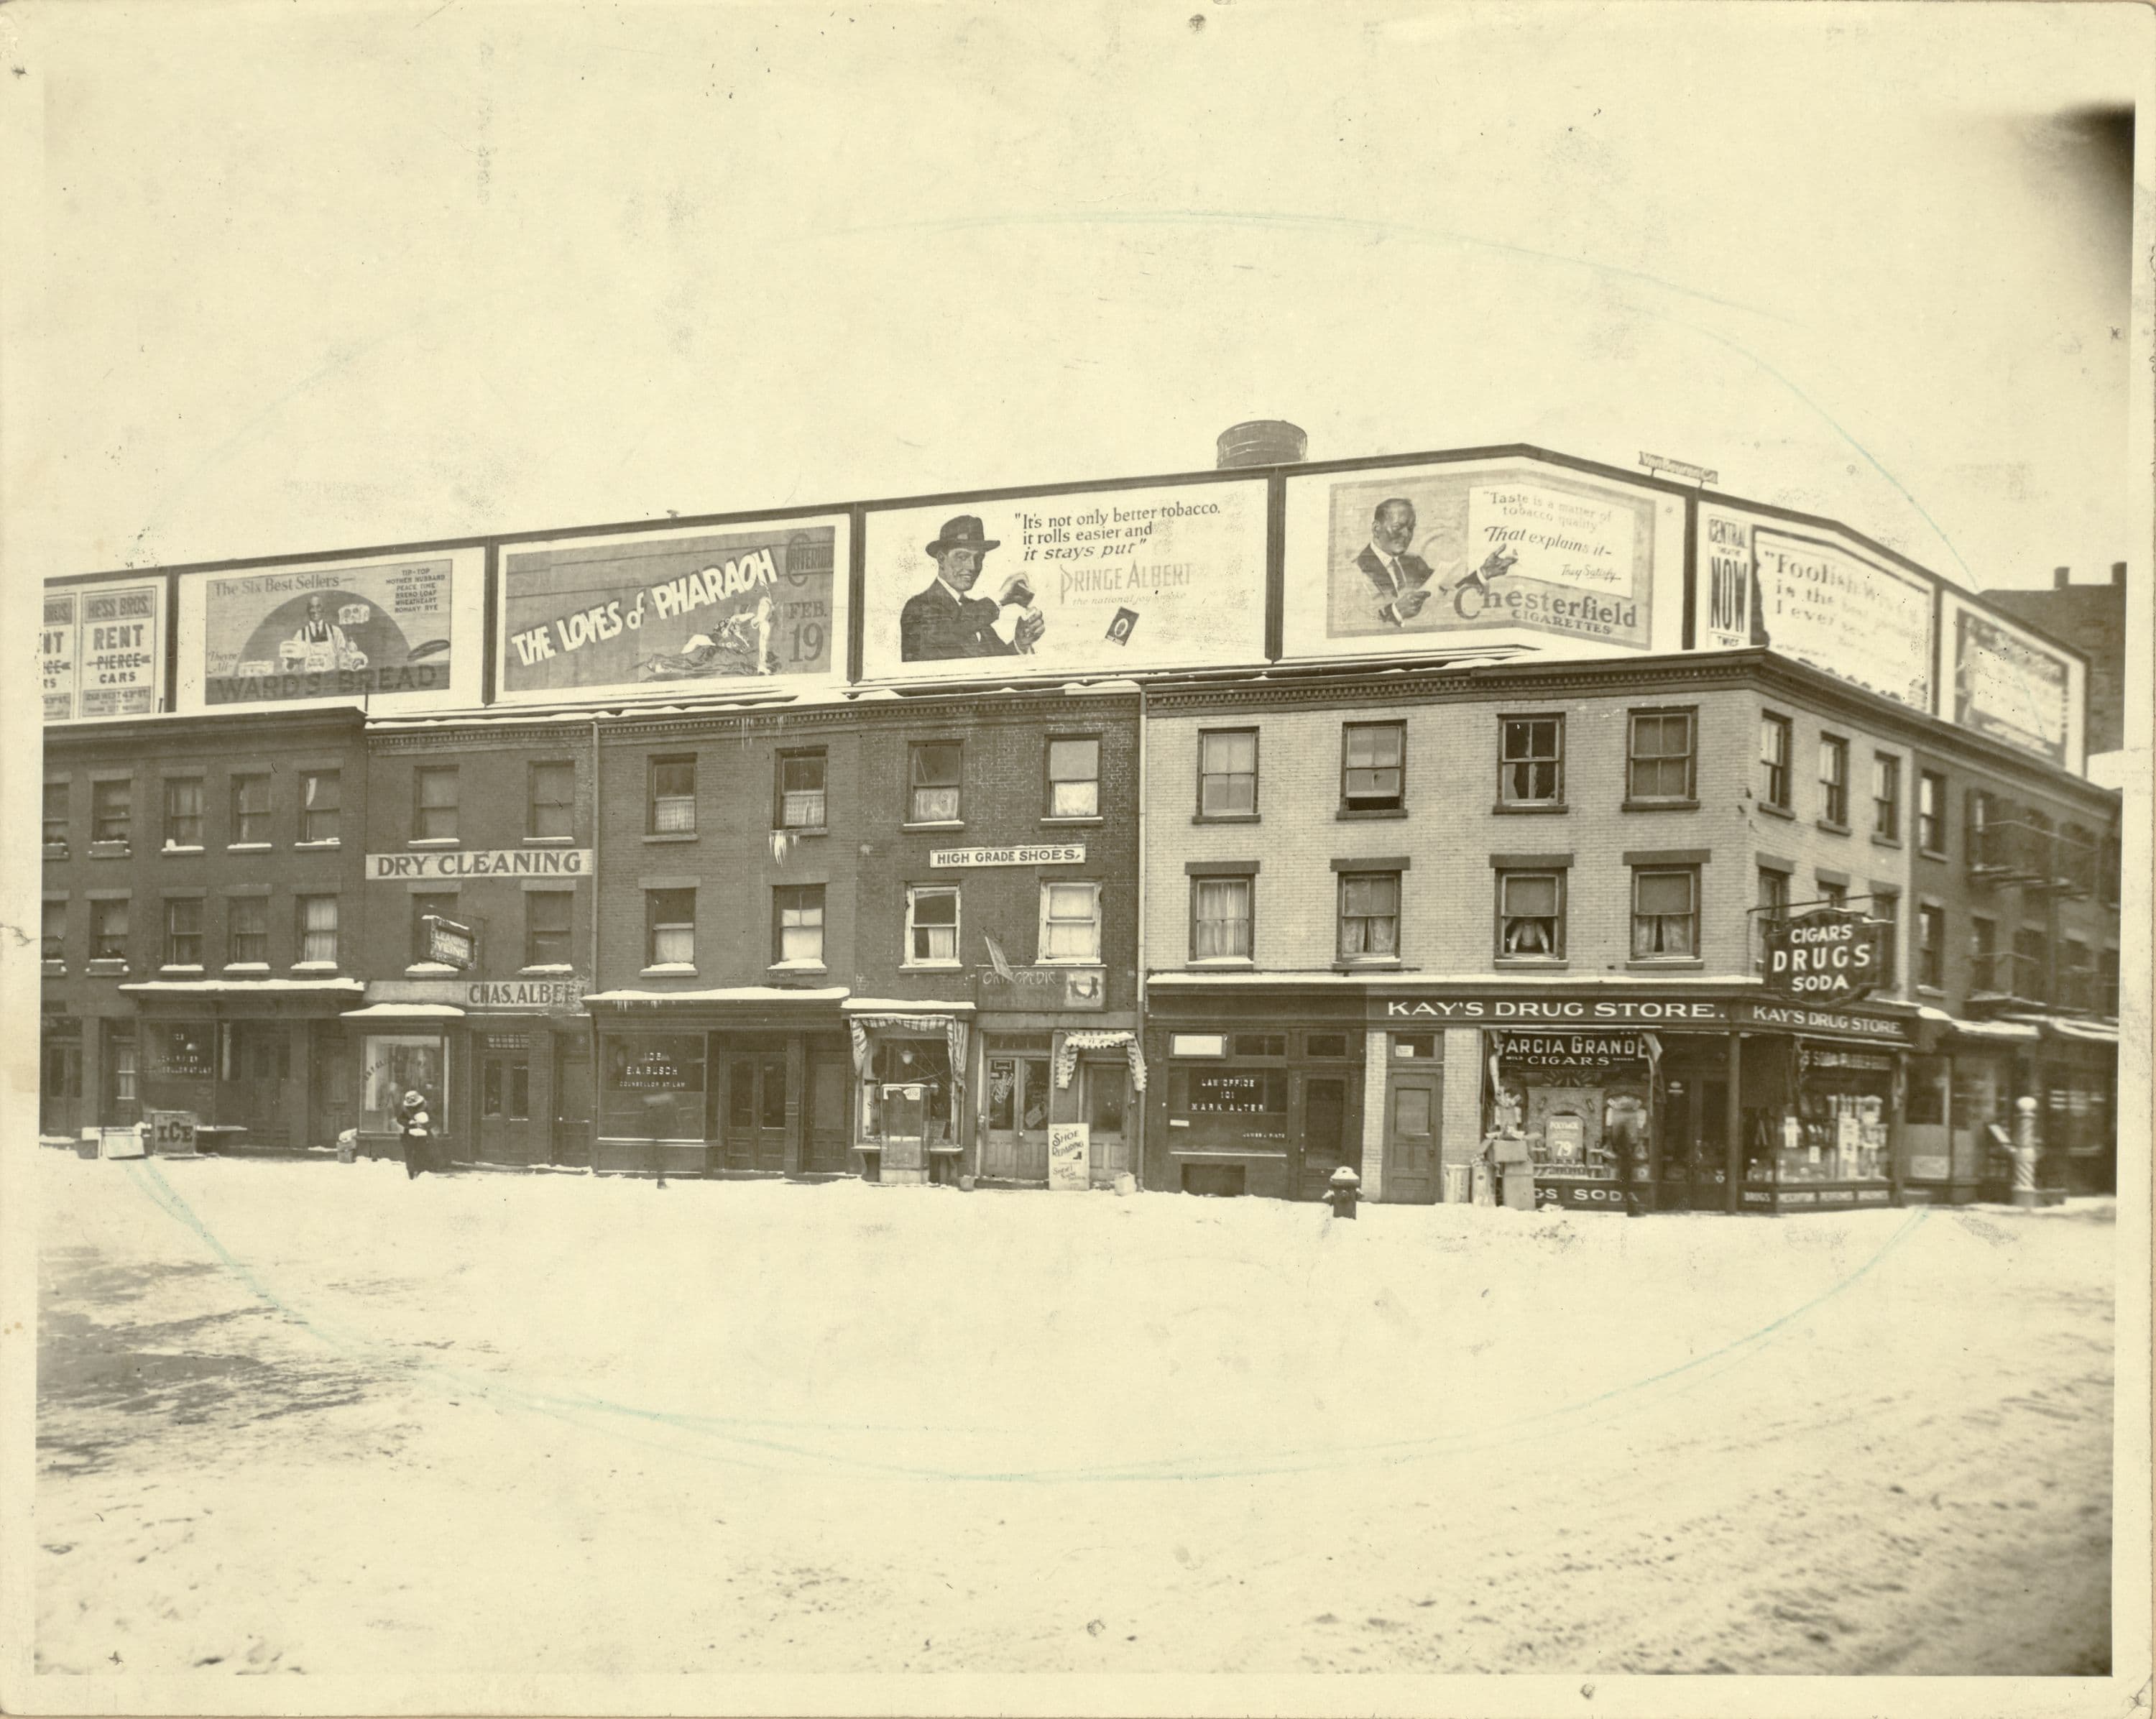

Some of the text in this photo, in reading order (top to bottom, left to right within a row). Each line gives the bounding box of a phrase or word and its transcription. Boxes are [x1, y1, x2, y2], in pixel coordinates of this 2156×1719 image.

[1533, 494, 1543, 506] is
[1049, 515, 1072, 528] not
[1077, 509, 1108, 526] only
[1113, 507, 1157, 522] better
[1161, 501, 1221, 518] tobacco.
[1503, 502, 1553, 522] tobacco
[1023, 522, 1152, 545] it rolls easier and
[1484, 525, 1526, 542] That
[1529, 532, 1589, 554] explains
[1023, 538, 1146, 561] it stays put"
[1127, 559, 1193, 589] ALBERT
[216, 582, 239, 596] The
[241, 580, 261, 594] Six
[265, 578, 293, 593] Best
[1710, 556, 1747, 632] NOW
[87, 597, 116, 619] HESS
[512, 548, 778, 666] THE LOVES of PHARAOH
[788, 601, 827, 619] FEB.
[1454, 585, 1637, 627] Chesterfield
[1511, 609, 1612, 635] CIGARETTES
[93, 624, 144, 650] RENT
[789, 622, 824, 663] 19
[97, 653, 141, 670] PIERCE
[99, 672, 137, 683] CARS
[338, 663, 438, 693] BREAD
[377, 852, 582, 877] DRY CLEANING
[937, 852, 969, 865] HIGH
[975, 850, 1015, 862] GRADE
[1790, 924, 1853, 944] CIGARS
[1772, 944, 1871, 972] DRUGS
[469, 983, 515, 1004] CHAS.
[1792, 974, 1850, 992] SODA
[1387, 1001, 1726, 1019] KAY'S DRUG STORE.
[1752, 1005, 1904, 1036] KAY'S DRUG STORE
[1571, 1036, 1649, 1059] GRANDE
[1527, 1055, 1611, 1066] CIGARS
[1222, 1079, 1255, 1087] OFFICE
[1229, 1103, 1264, 1112] ALTER
[157, 1122, 194, 1143] ICE
[1051, 1130, 1078, 1147] SHOE
[1554, 1140, 1573, 1157] 79
